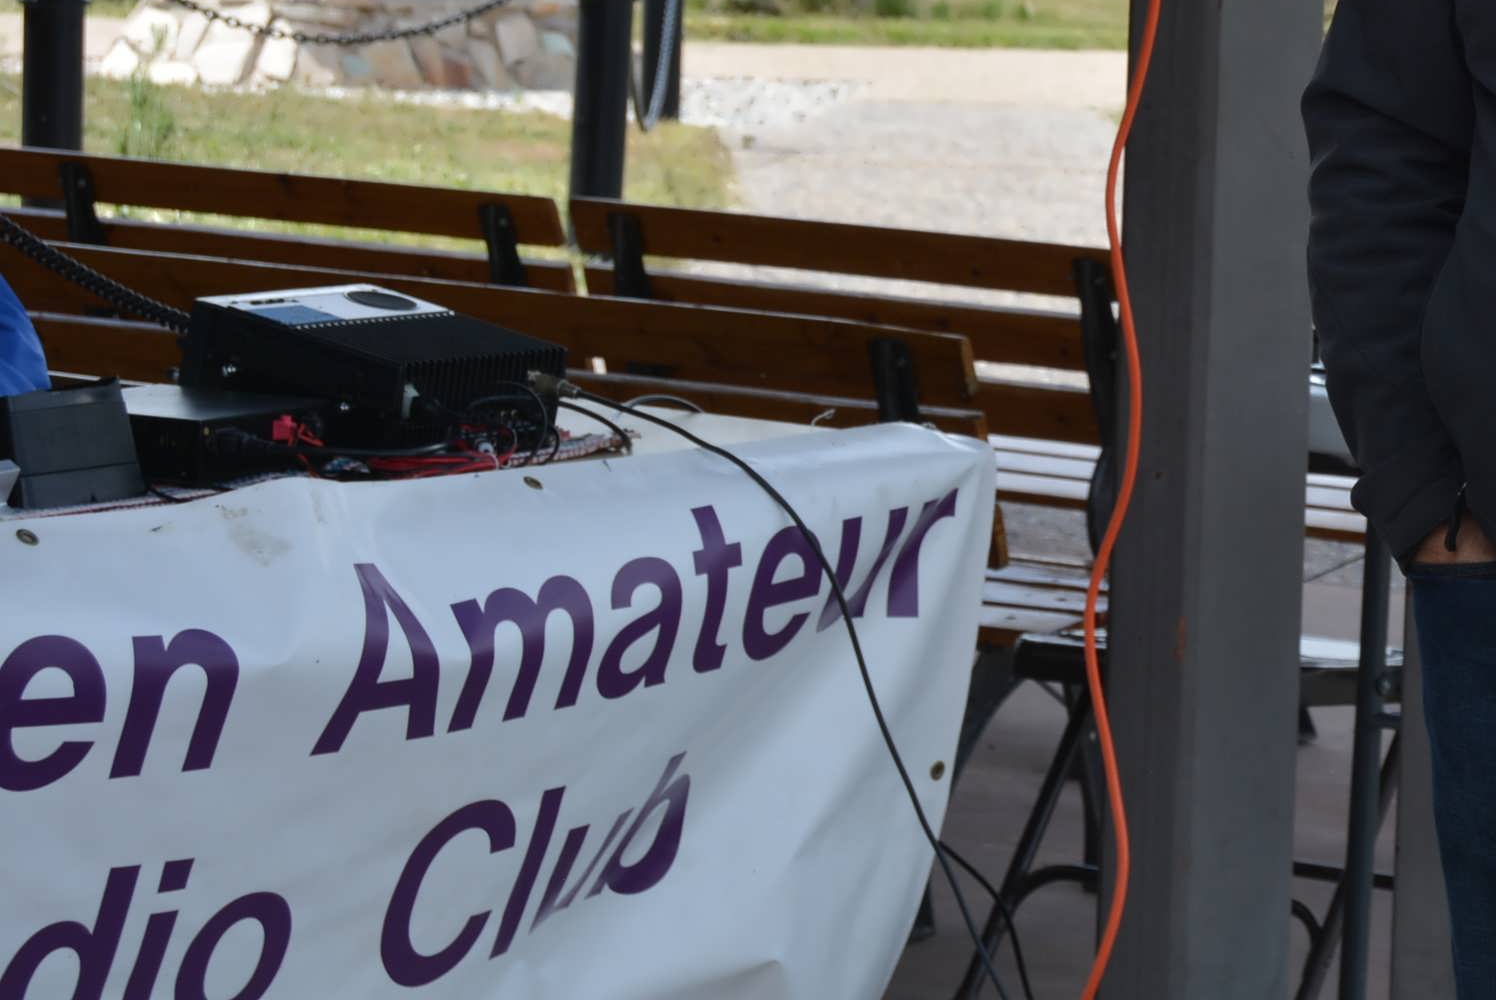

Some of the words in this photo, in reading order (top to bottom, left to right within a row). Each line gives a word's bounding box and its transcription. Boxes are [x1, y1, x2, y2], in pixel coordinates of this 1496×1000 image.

[0, 628, 241, 792] en
[311, 487, 957, 755] Amateur
[0, 857, 293, 1000] dio
[380, 750, 692, 988] Club
